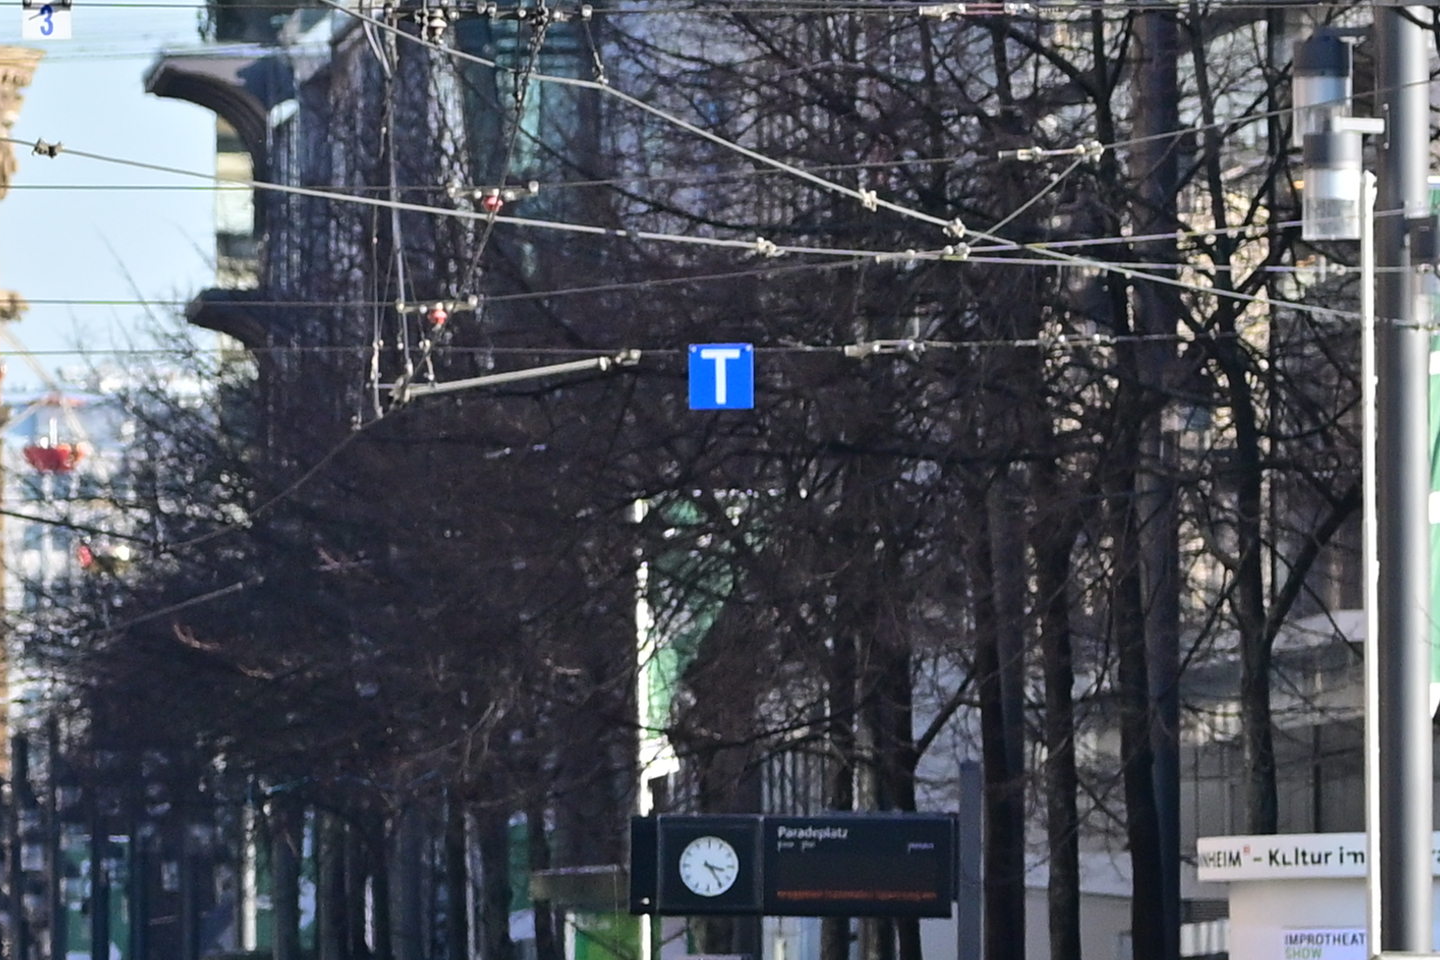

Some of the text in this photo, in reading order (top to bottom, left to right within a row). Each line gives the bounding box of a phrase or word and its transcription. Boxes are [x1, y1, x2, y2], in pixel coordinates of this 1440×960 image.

[40, 4, 54, 36] 3
[701, 348, 741, 406] T
[1284, 947, 1323, 960] SHOW
